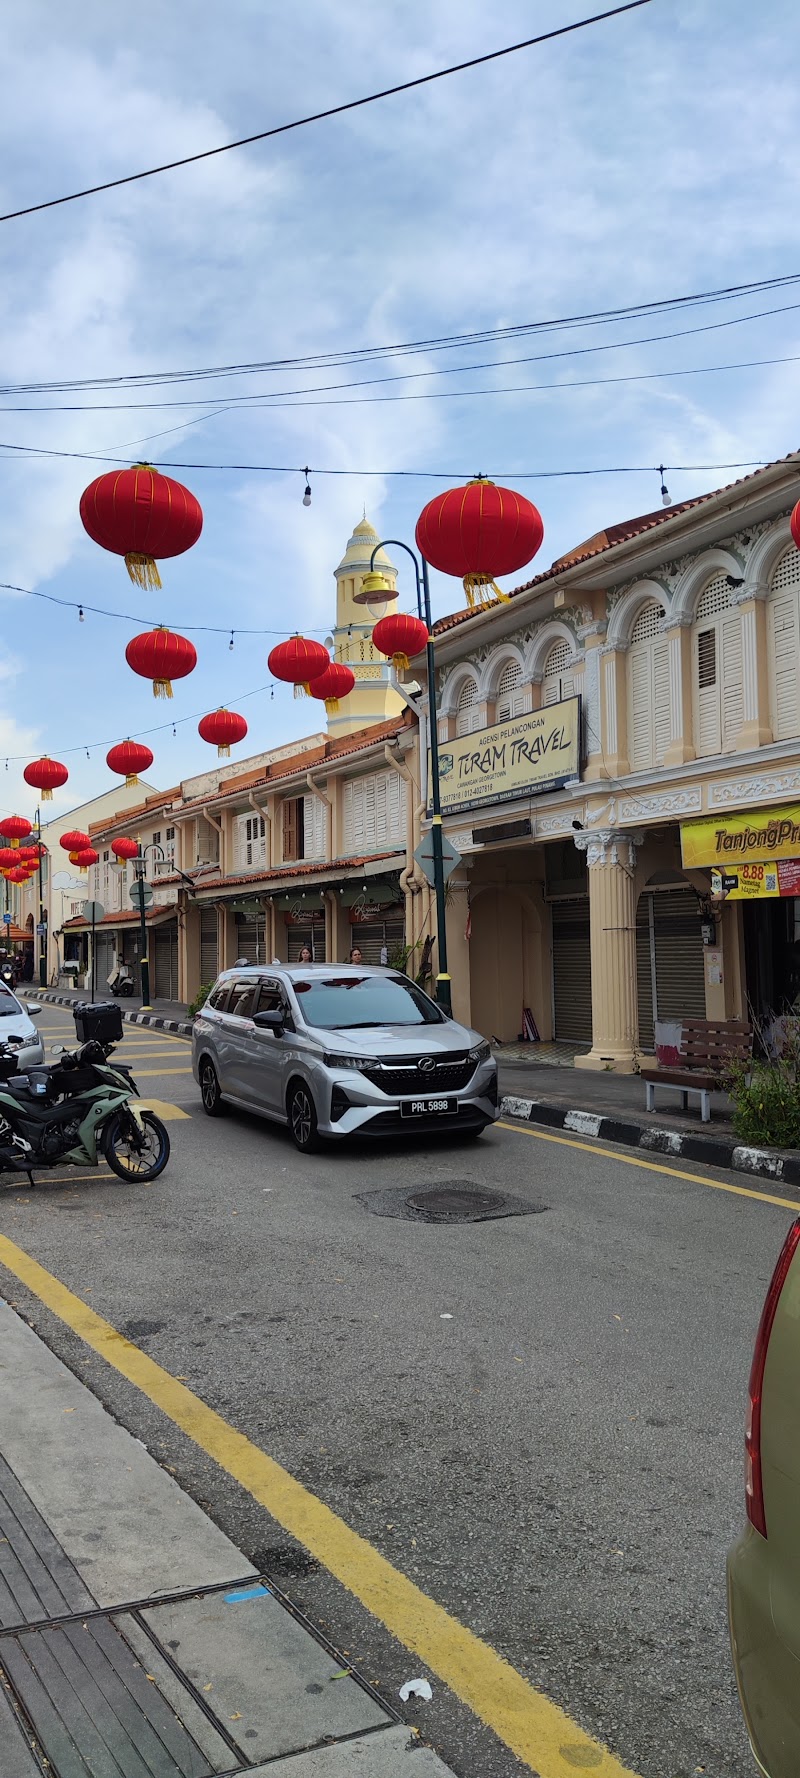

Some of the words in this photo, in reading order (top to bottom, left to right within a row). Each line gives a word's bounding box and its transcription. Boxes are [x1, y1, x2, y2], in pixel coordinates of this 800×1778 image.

[479, 733, 500, 746] AGENSI
[500, 717, 545, 739] PELANCONGAN
[510, 726, 571, 765] TRAVEL
[479, 770, 507, 784] GEORGETOWN
[743, 864, 764, 880] 8.88
[740, 878, 760, 888] Nametag
[741, 886, 759, 894] Magnet
[412, 1102, 428, 1112] PRL
[428, 1100, 448, 1111] 5898
